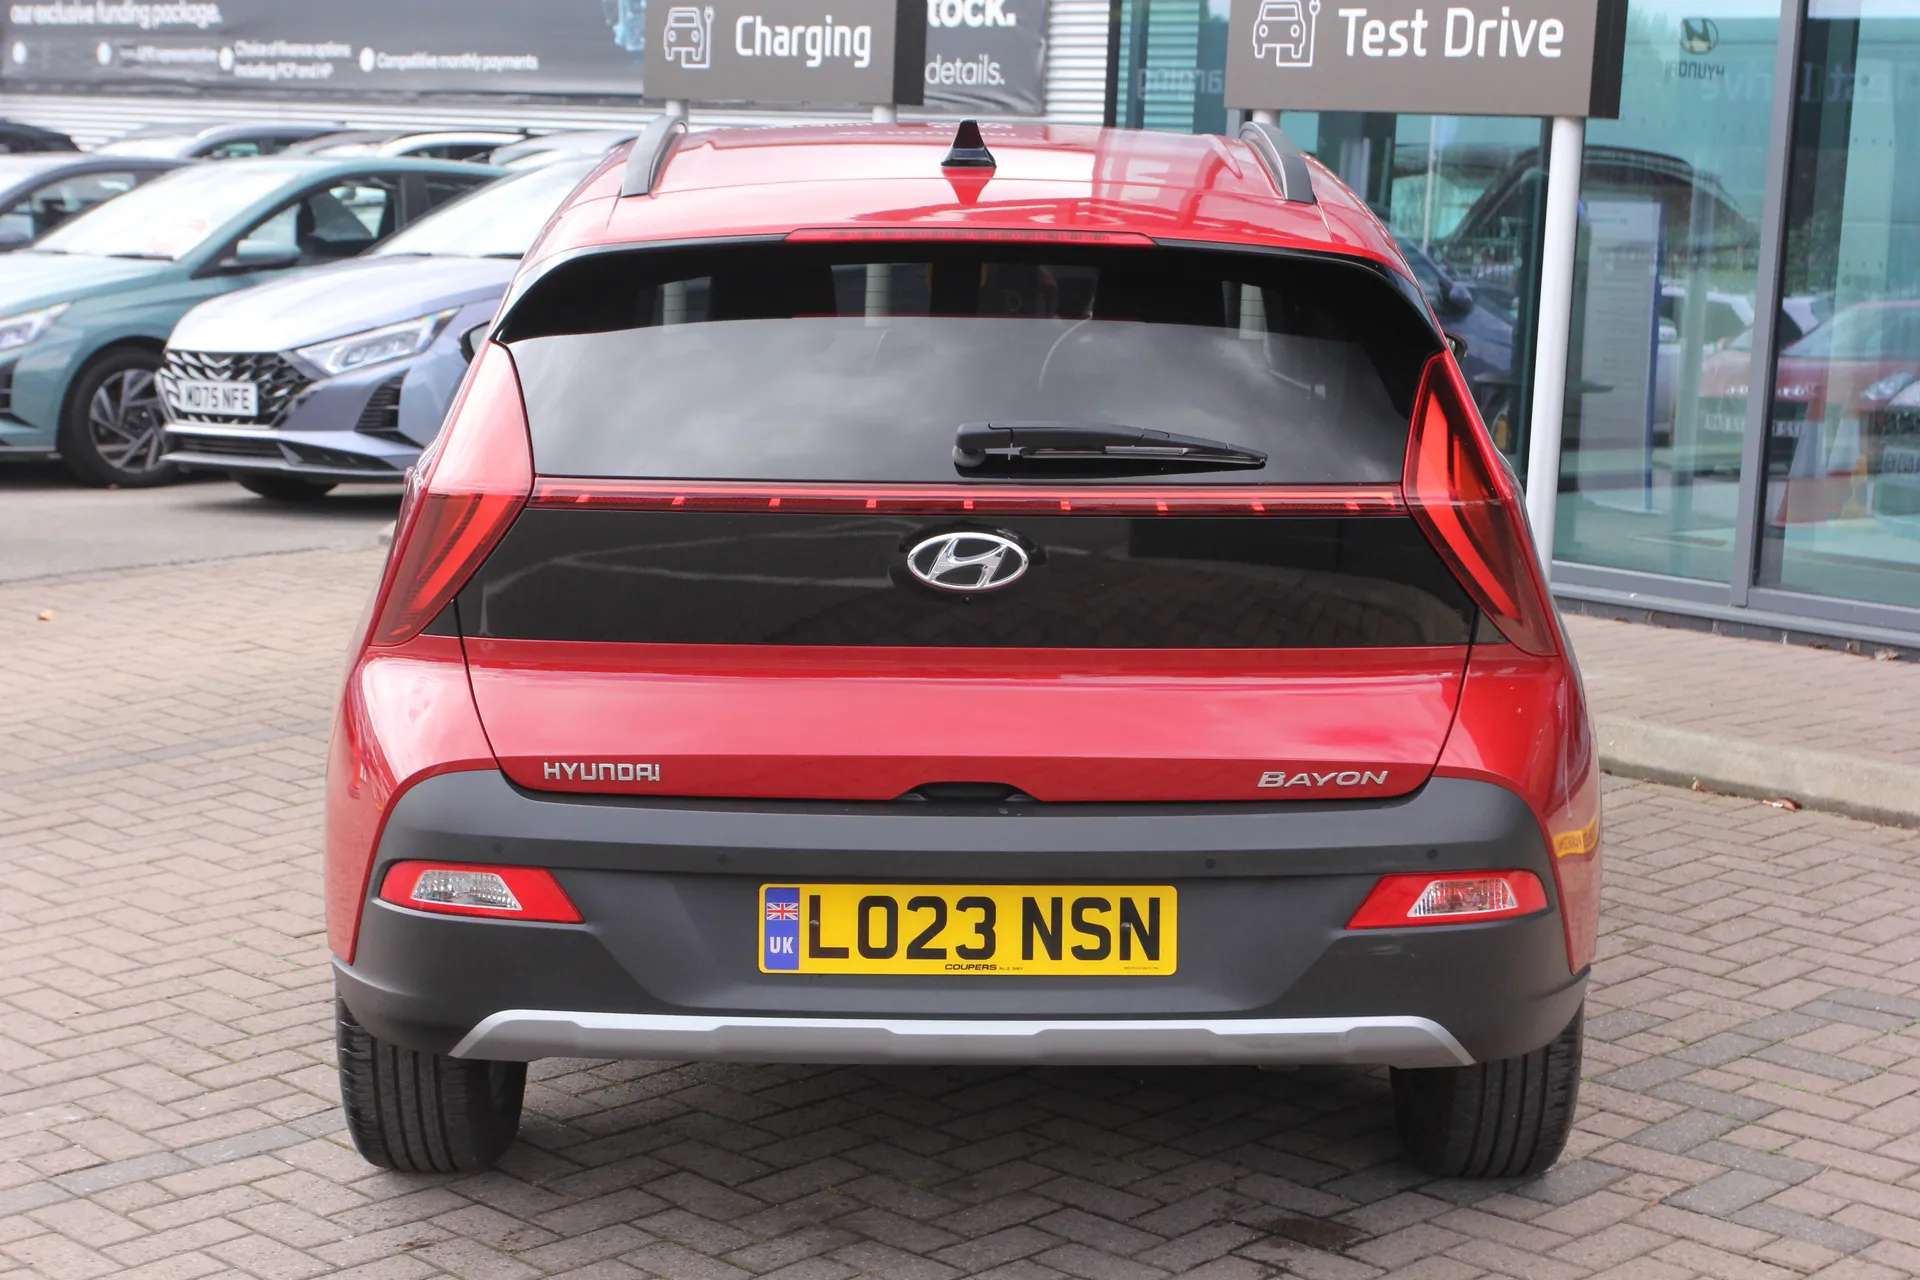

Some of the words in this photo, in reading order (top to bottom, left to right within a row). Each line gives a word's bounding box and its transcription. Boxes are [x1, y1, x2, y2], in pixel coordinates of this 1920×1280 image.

[735, 14, 872, 68] Charging
[1338, 8, 1428, 57] Test
[1444, 6, 1564, 58] Drive
[376, 52, 437, 71] Competitive
[925, 53, 1006, 85] details.
[543, 762, 660, 781] HYUNDAI
[1257, 770, 1388, 788] BAYON
[808, 894, 996, 961] LO23
[1021, 896, 1161, 961] NSN
[769, 936, 793, 954] UK
[944, 963, 998, 971] COUPERS
